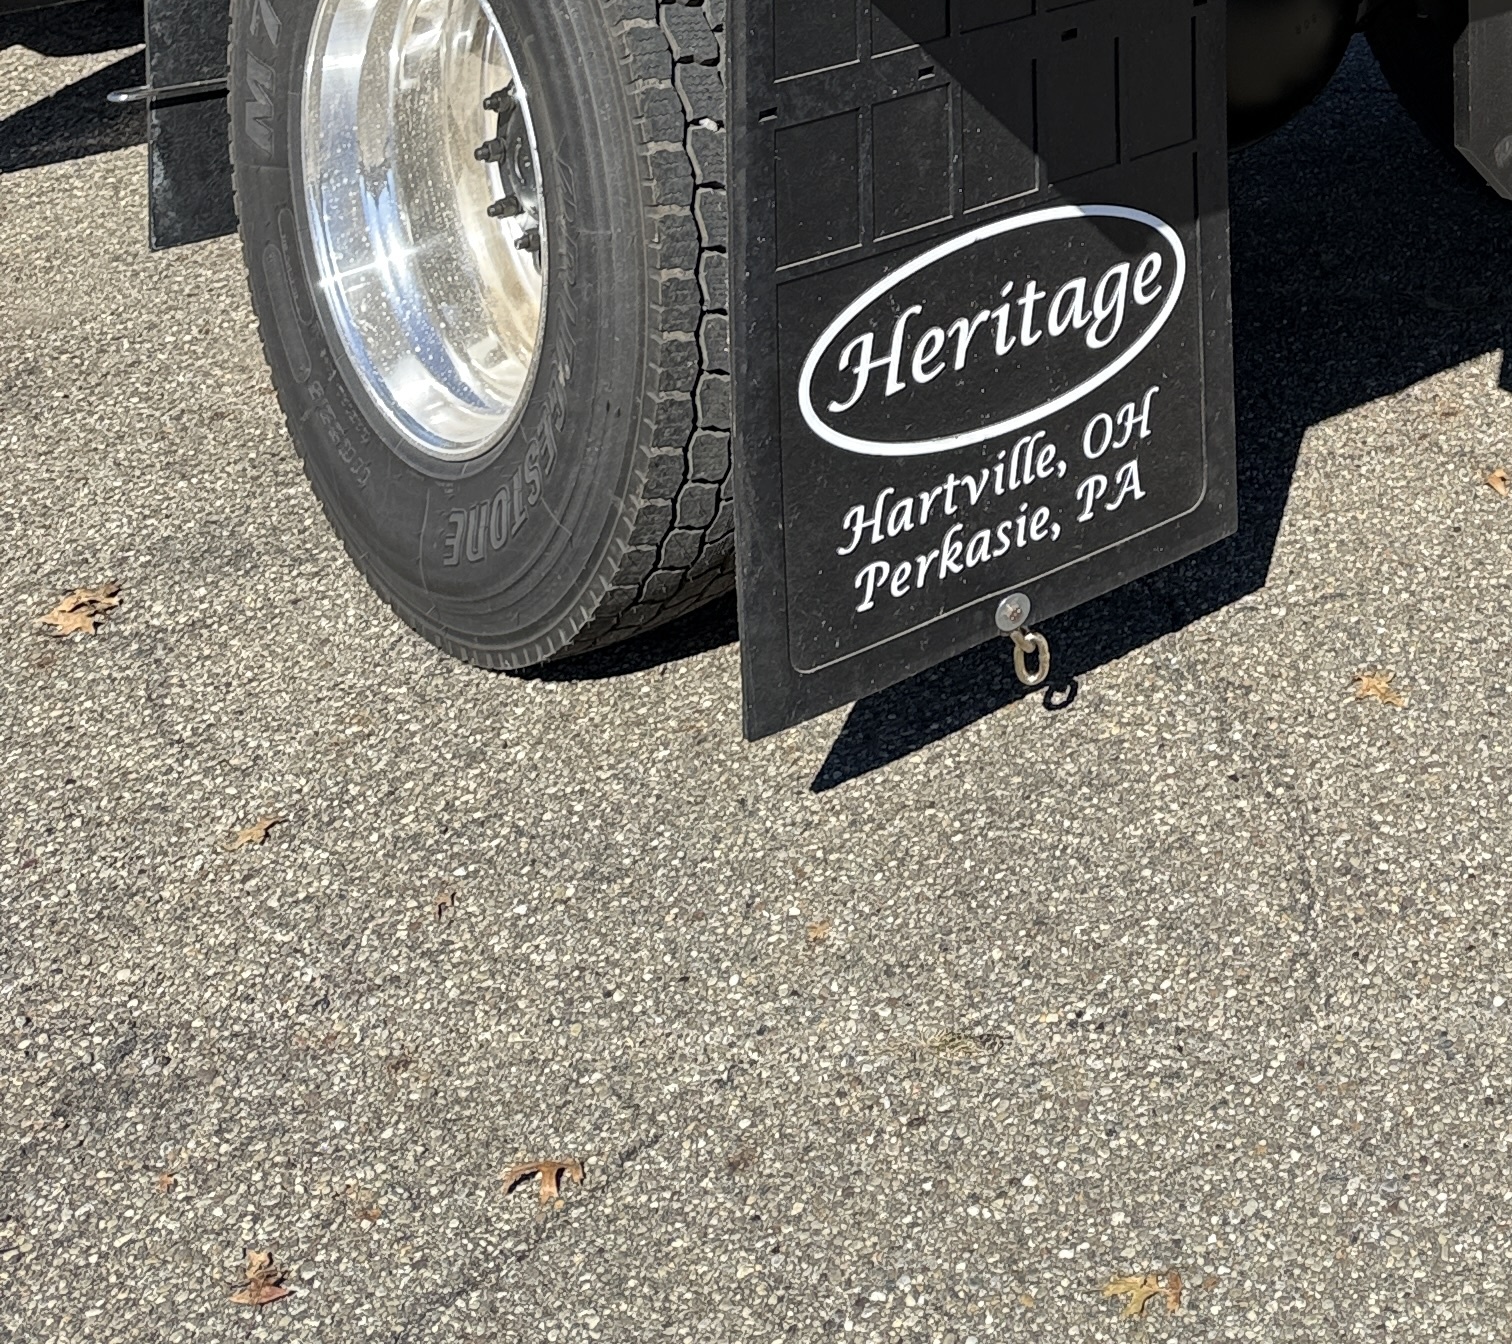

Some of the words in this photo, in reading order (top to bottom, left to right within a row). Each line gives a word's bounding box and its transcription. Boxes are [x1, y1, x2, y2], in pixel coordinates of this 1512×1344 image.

[827, 252, 1163, 413] Heritage
[836, 431, 1067, 556] Hartville,
[1082, 386, 1160, 460] OH
[855, 503, 1062, 613] Perkasie,
[1075, 460, 1146, 523] PA
